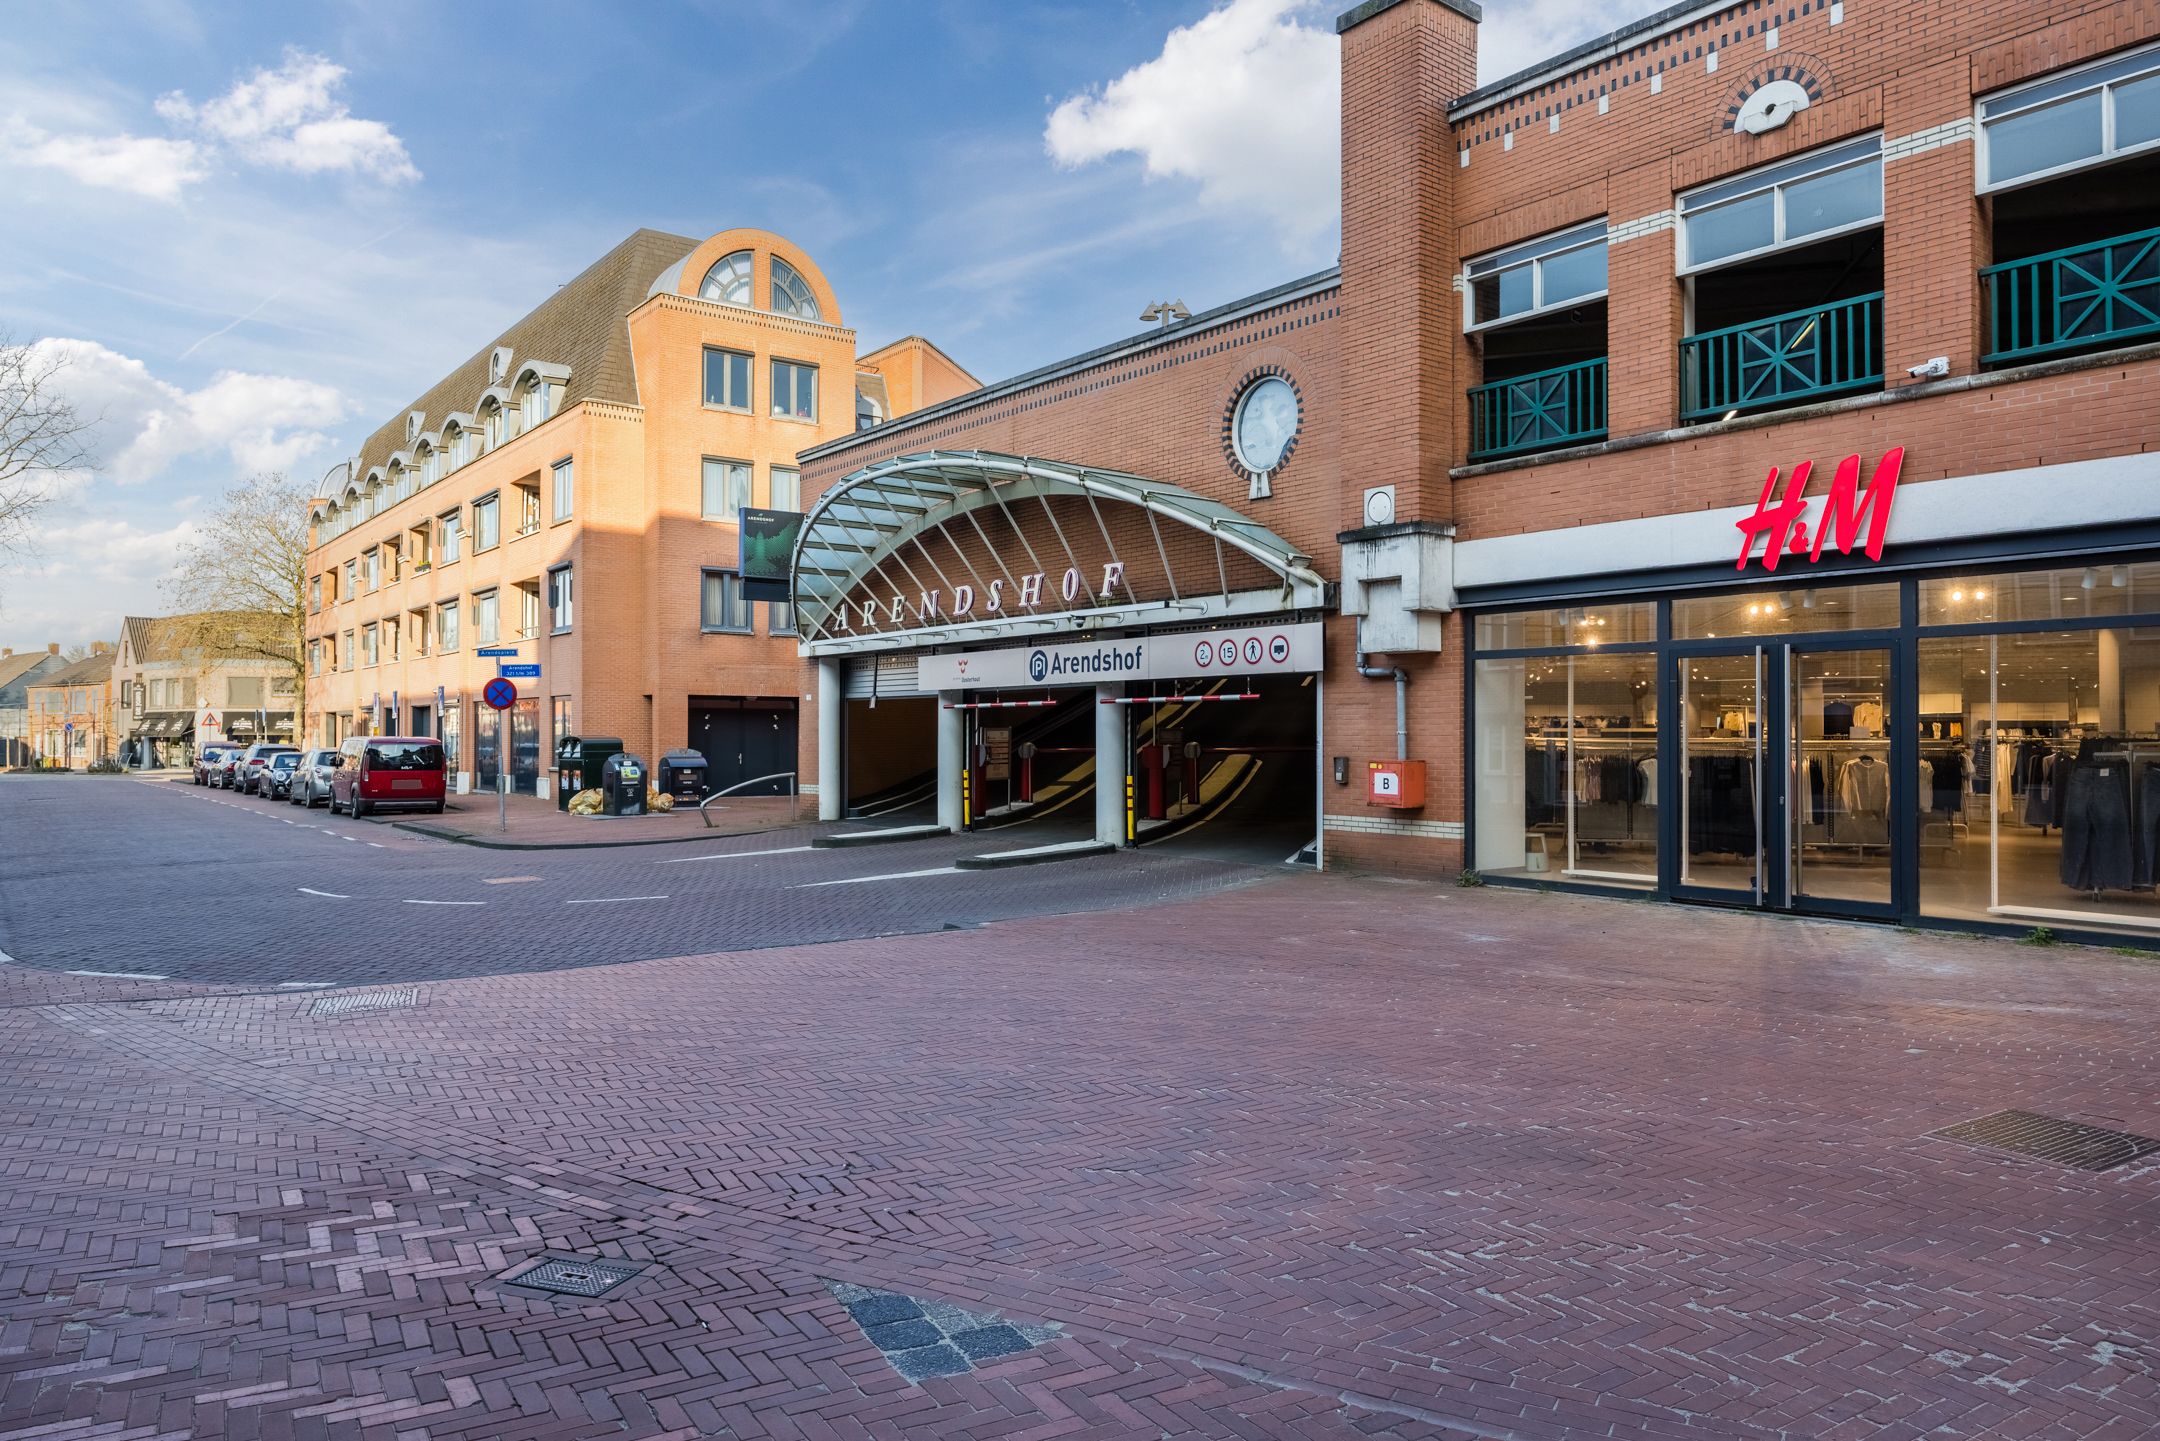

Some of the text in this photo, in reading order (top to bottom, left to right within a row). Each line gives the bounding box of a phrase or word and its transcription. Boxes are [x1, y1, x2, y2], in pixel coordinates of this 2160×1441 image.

[1735, 446, 1905, 572] H&M
[832, 562, 1125, 632] ARENDSHOF
[1051, 645, 1142, 675] Arendshof
[1222, 647, 1234, 659] 15
[1382, 777, 1390, 790] B
